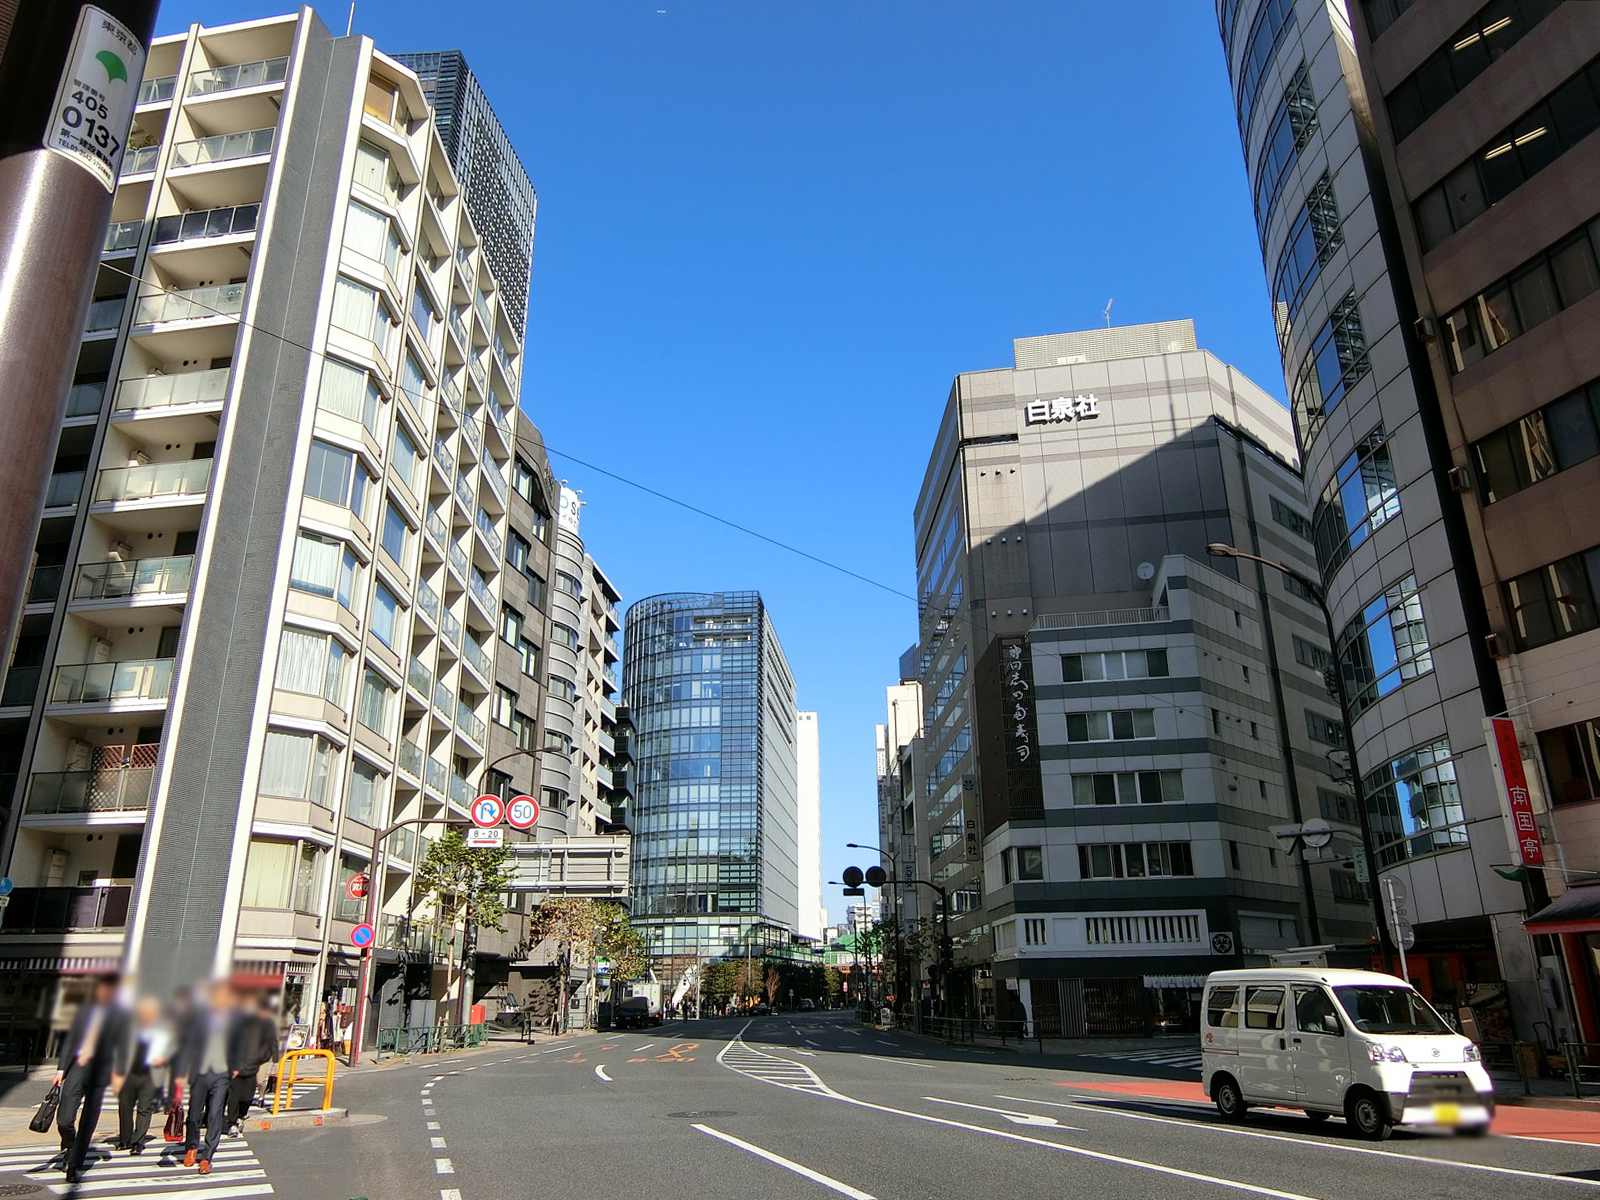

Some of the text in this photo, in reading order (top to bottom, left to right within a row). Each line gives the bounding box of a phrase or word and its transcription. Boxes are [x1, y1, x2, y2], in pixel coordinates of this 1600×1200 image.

[101, 19, 138, 56] 東京都
[71, 90, 109, 120] 405
[62, 105, 120, 158] 0137
[1025, 393, 1100, 425] 白泉社
[513, 804, 532, 819] 50
[1509, 784, 1539, 859] 南国亭
[966, 819, 977, 856] 白泉社
